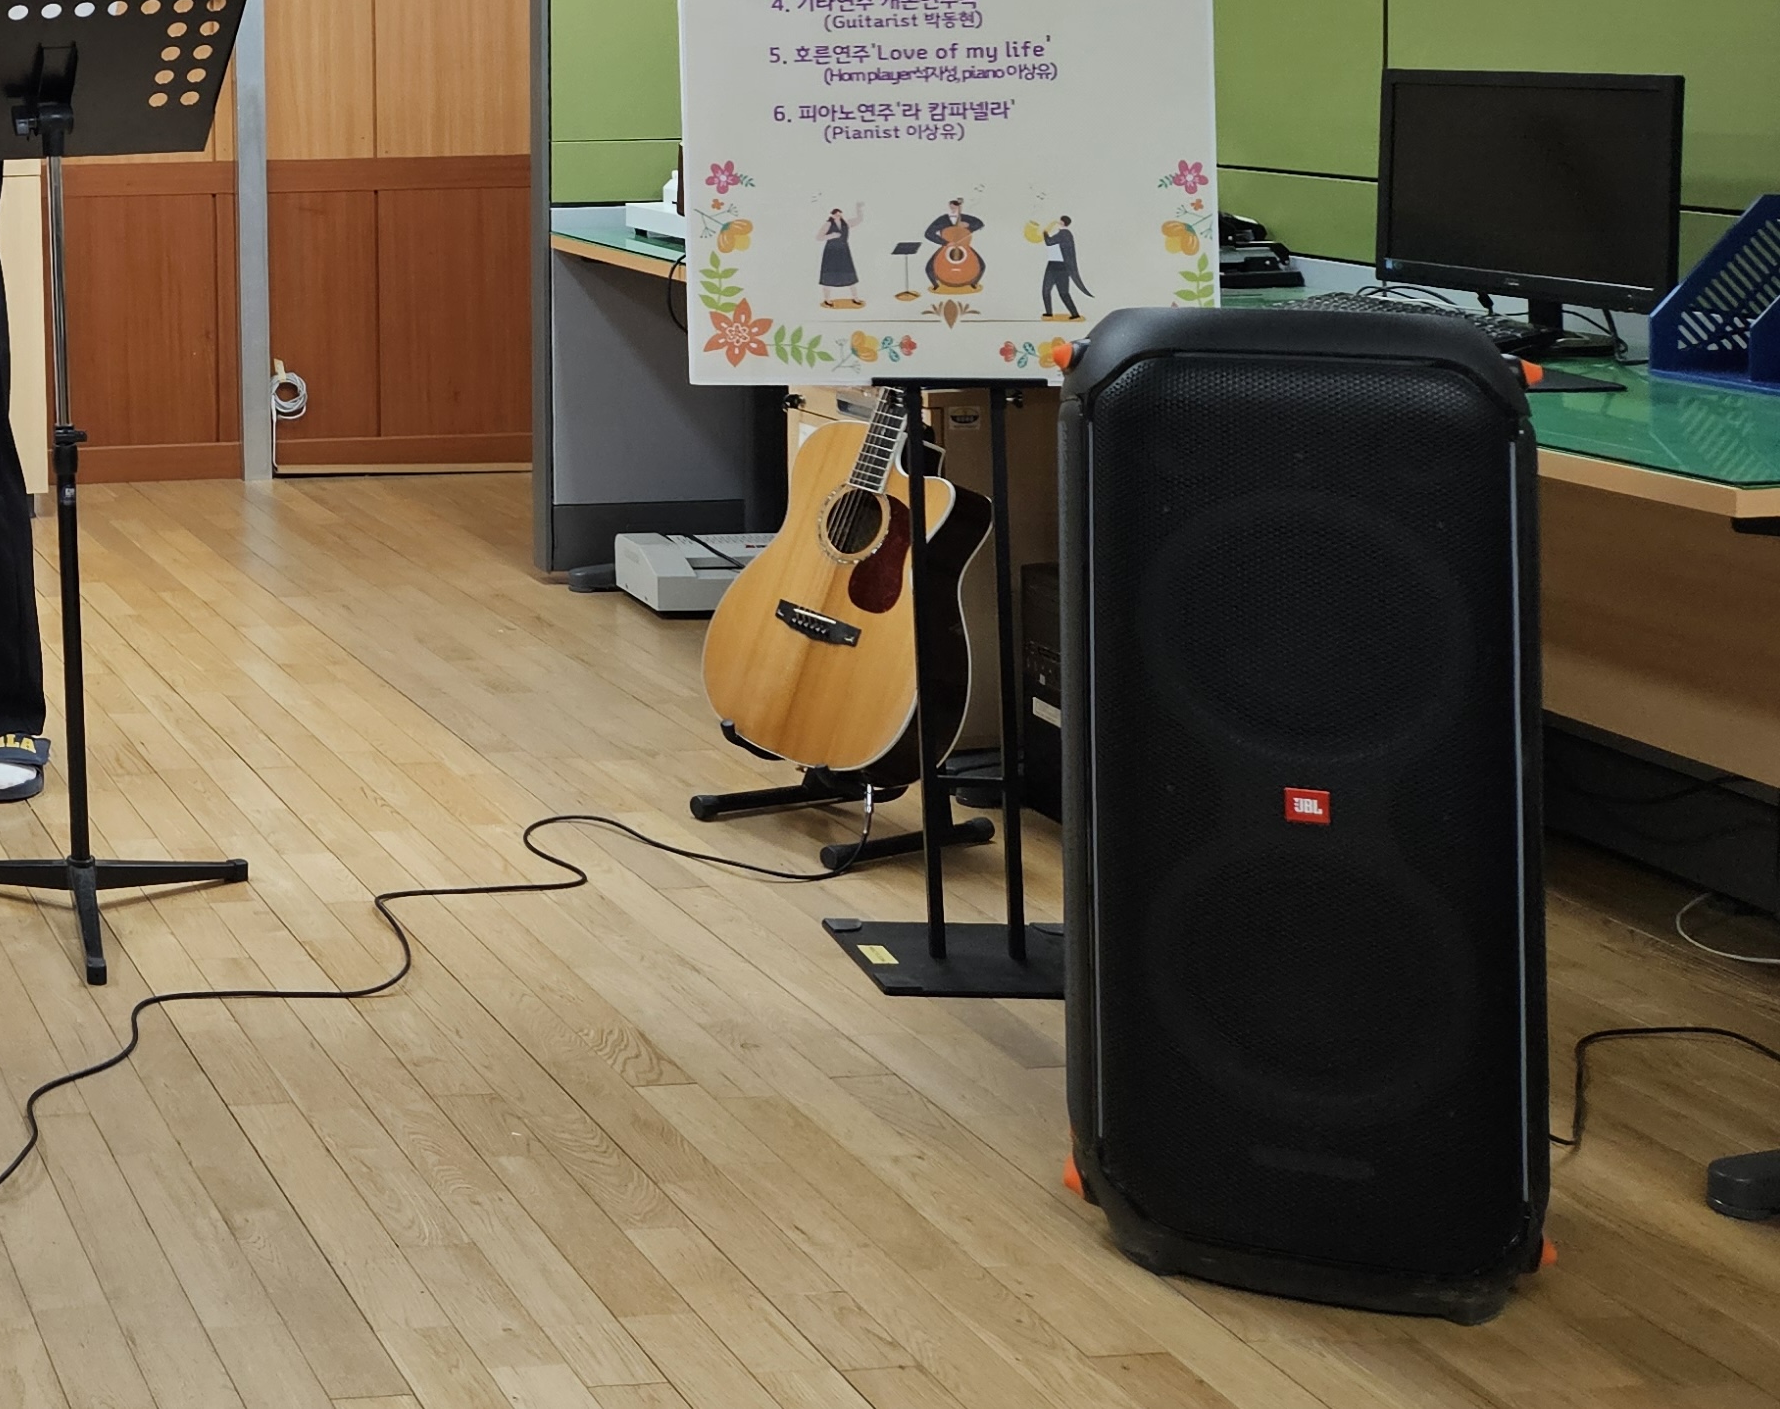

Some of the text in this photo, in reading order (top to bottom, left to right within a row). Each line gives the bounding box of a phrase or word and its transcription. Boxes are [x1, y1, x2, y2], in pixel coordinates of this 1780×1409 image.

[824, 11, 984, 32] (Guitarist 박동현)
[769, 47, 788, 65] 5.
[935, 42, 960, 60] of
[966, 46, 998, 63] my
[773, 105, 792, 123] 6.
[823, 122, 966, 143] (Pianist 이상유)
[1292, 797, 1323, 815] JBL
